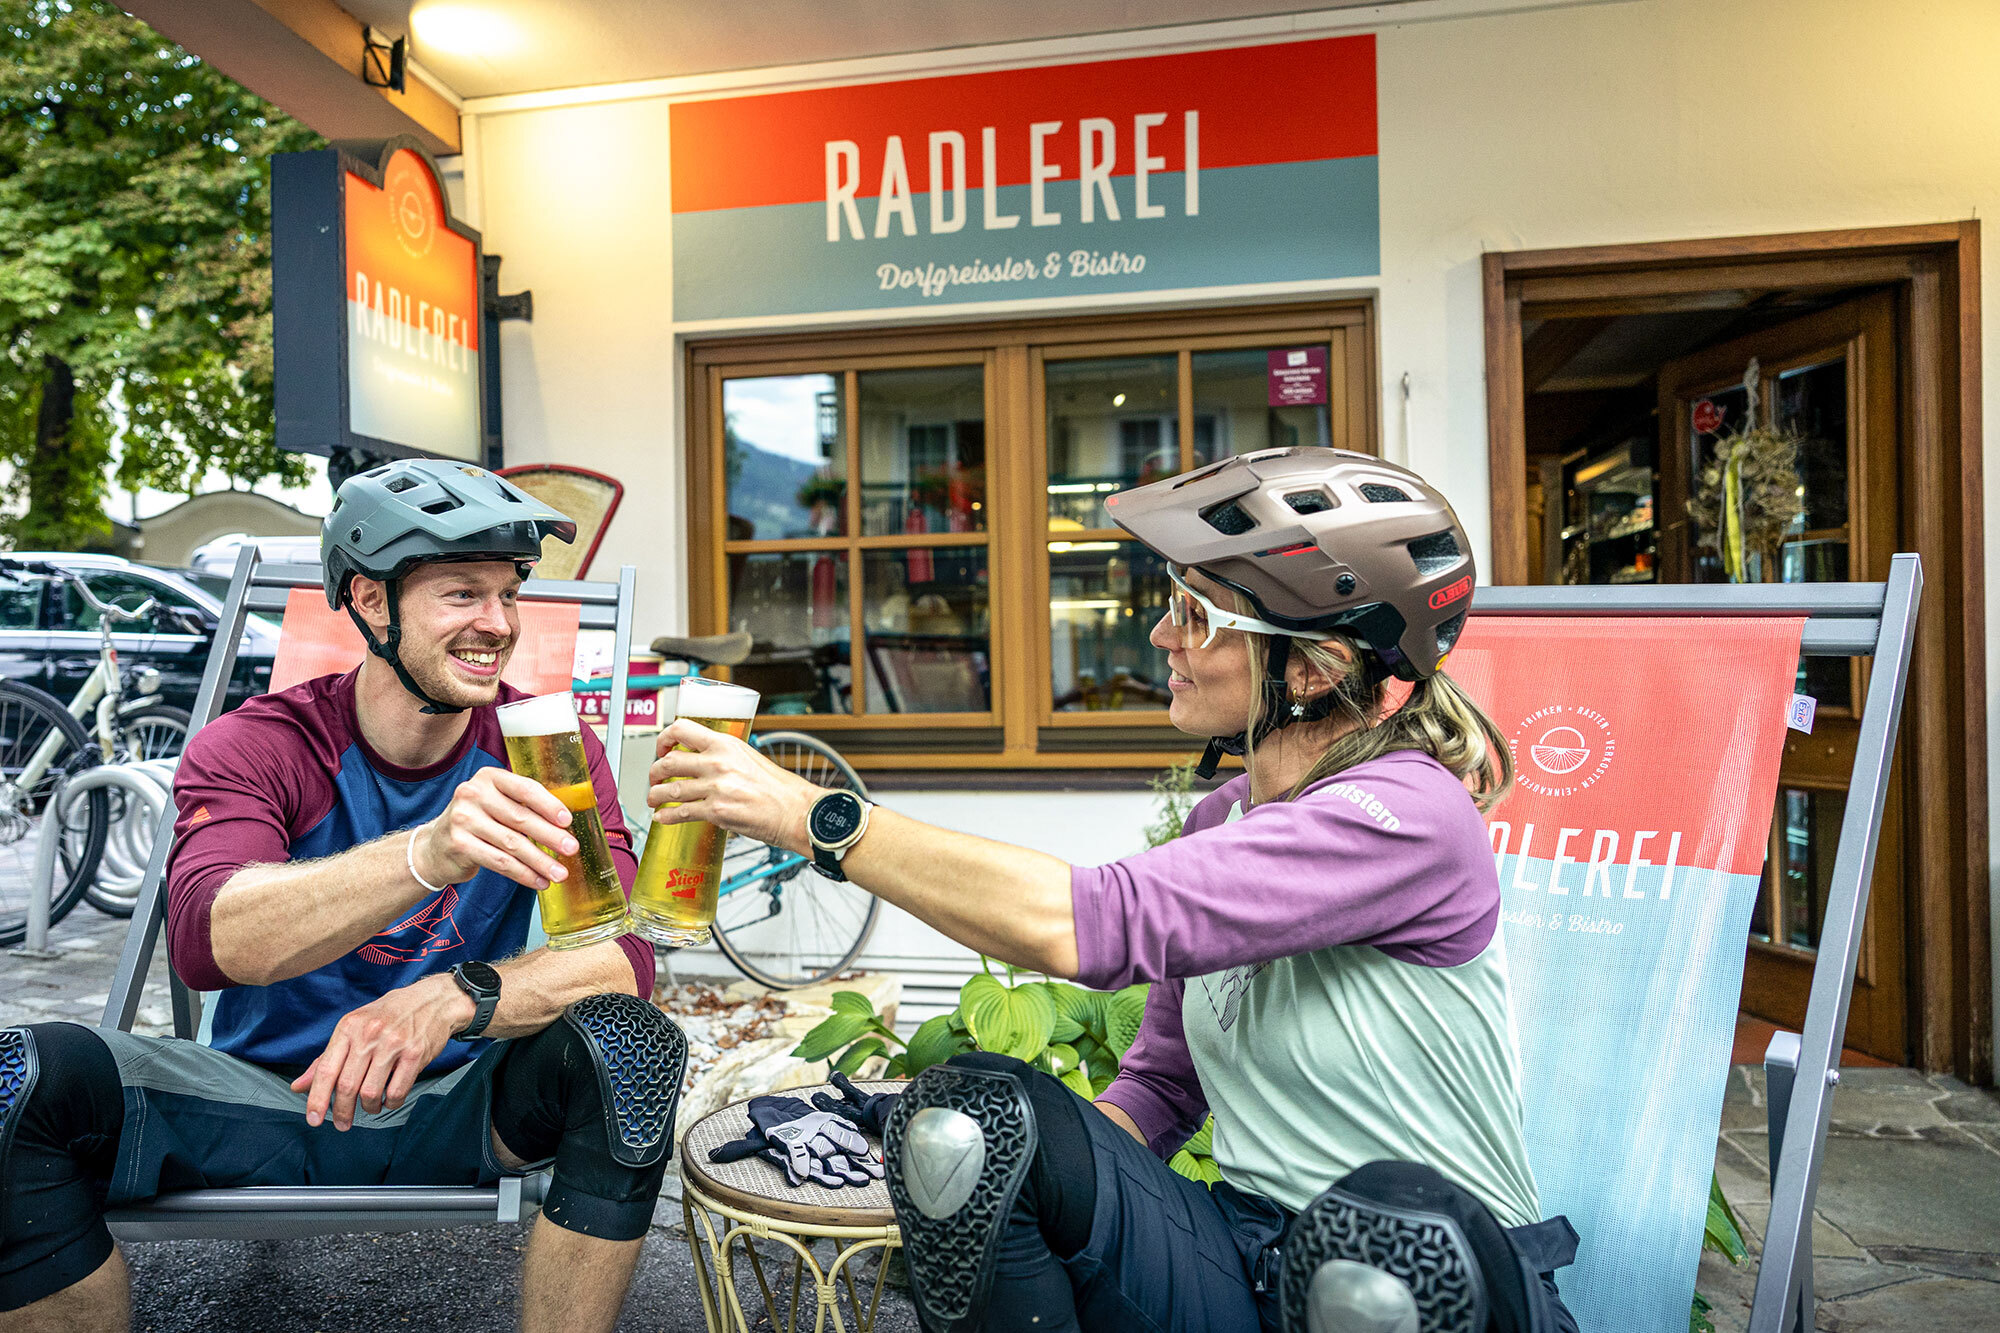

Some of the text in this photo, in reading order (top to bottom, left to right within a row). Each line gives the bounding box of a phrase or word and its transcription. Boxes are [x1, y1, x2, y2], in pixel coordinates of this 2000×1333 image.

[825, 110, 1199, 242] RADLEREI
[876, 248, 1146, 297] Dorfgreissler & Bistro
[356, 270, 468, 374] RADLEREI
[1434, 578, 1470, 606] ABUS
[584, 698, 598, 714] &
[601, 698, 656, 716] BTRO
[1520, 704, 1562, 728] TRINKEN
[1576, 706, 1610, 730] RASTEN
[1581, 739, 1616, 789] VERKOSTEN
[1517, 774, 1571, 797] EINKAUFEN
[824, 811, 847, 827] 18:07
[1487, 820, 1682, 900] DLEREI
[665, 868, 704, 889] Stiegl
[1548, 914, 1563, 931] &
[1568, 914, 1624, 935] Bistro
